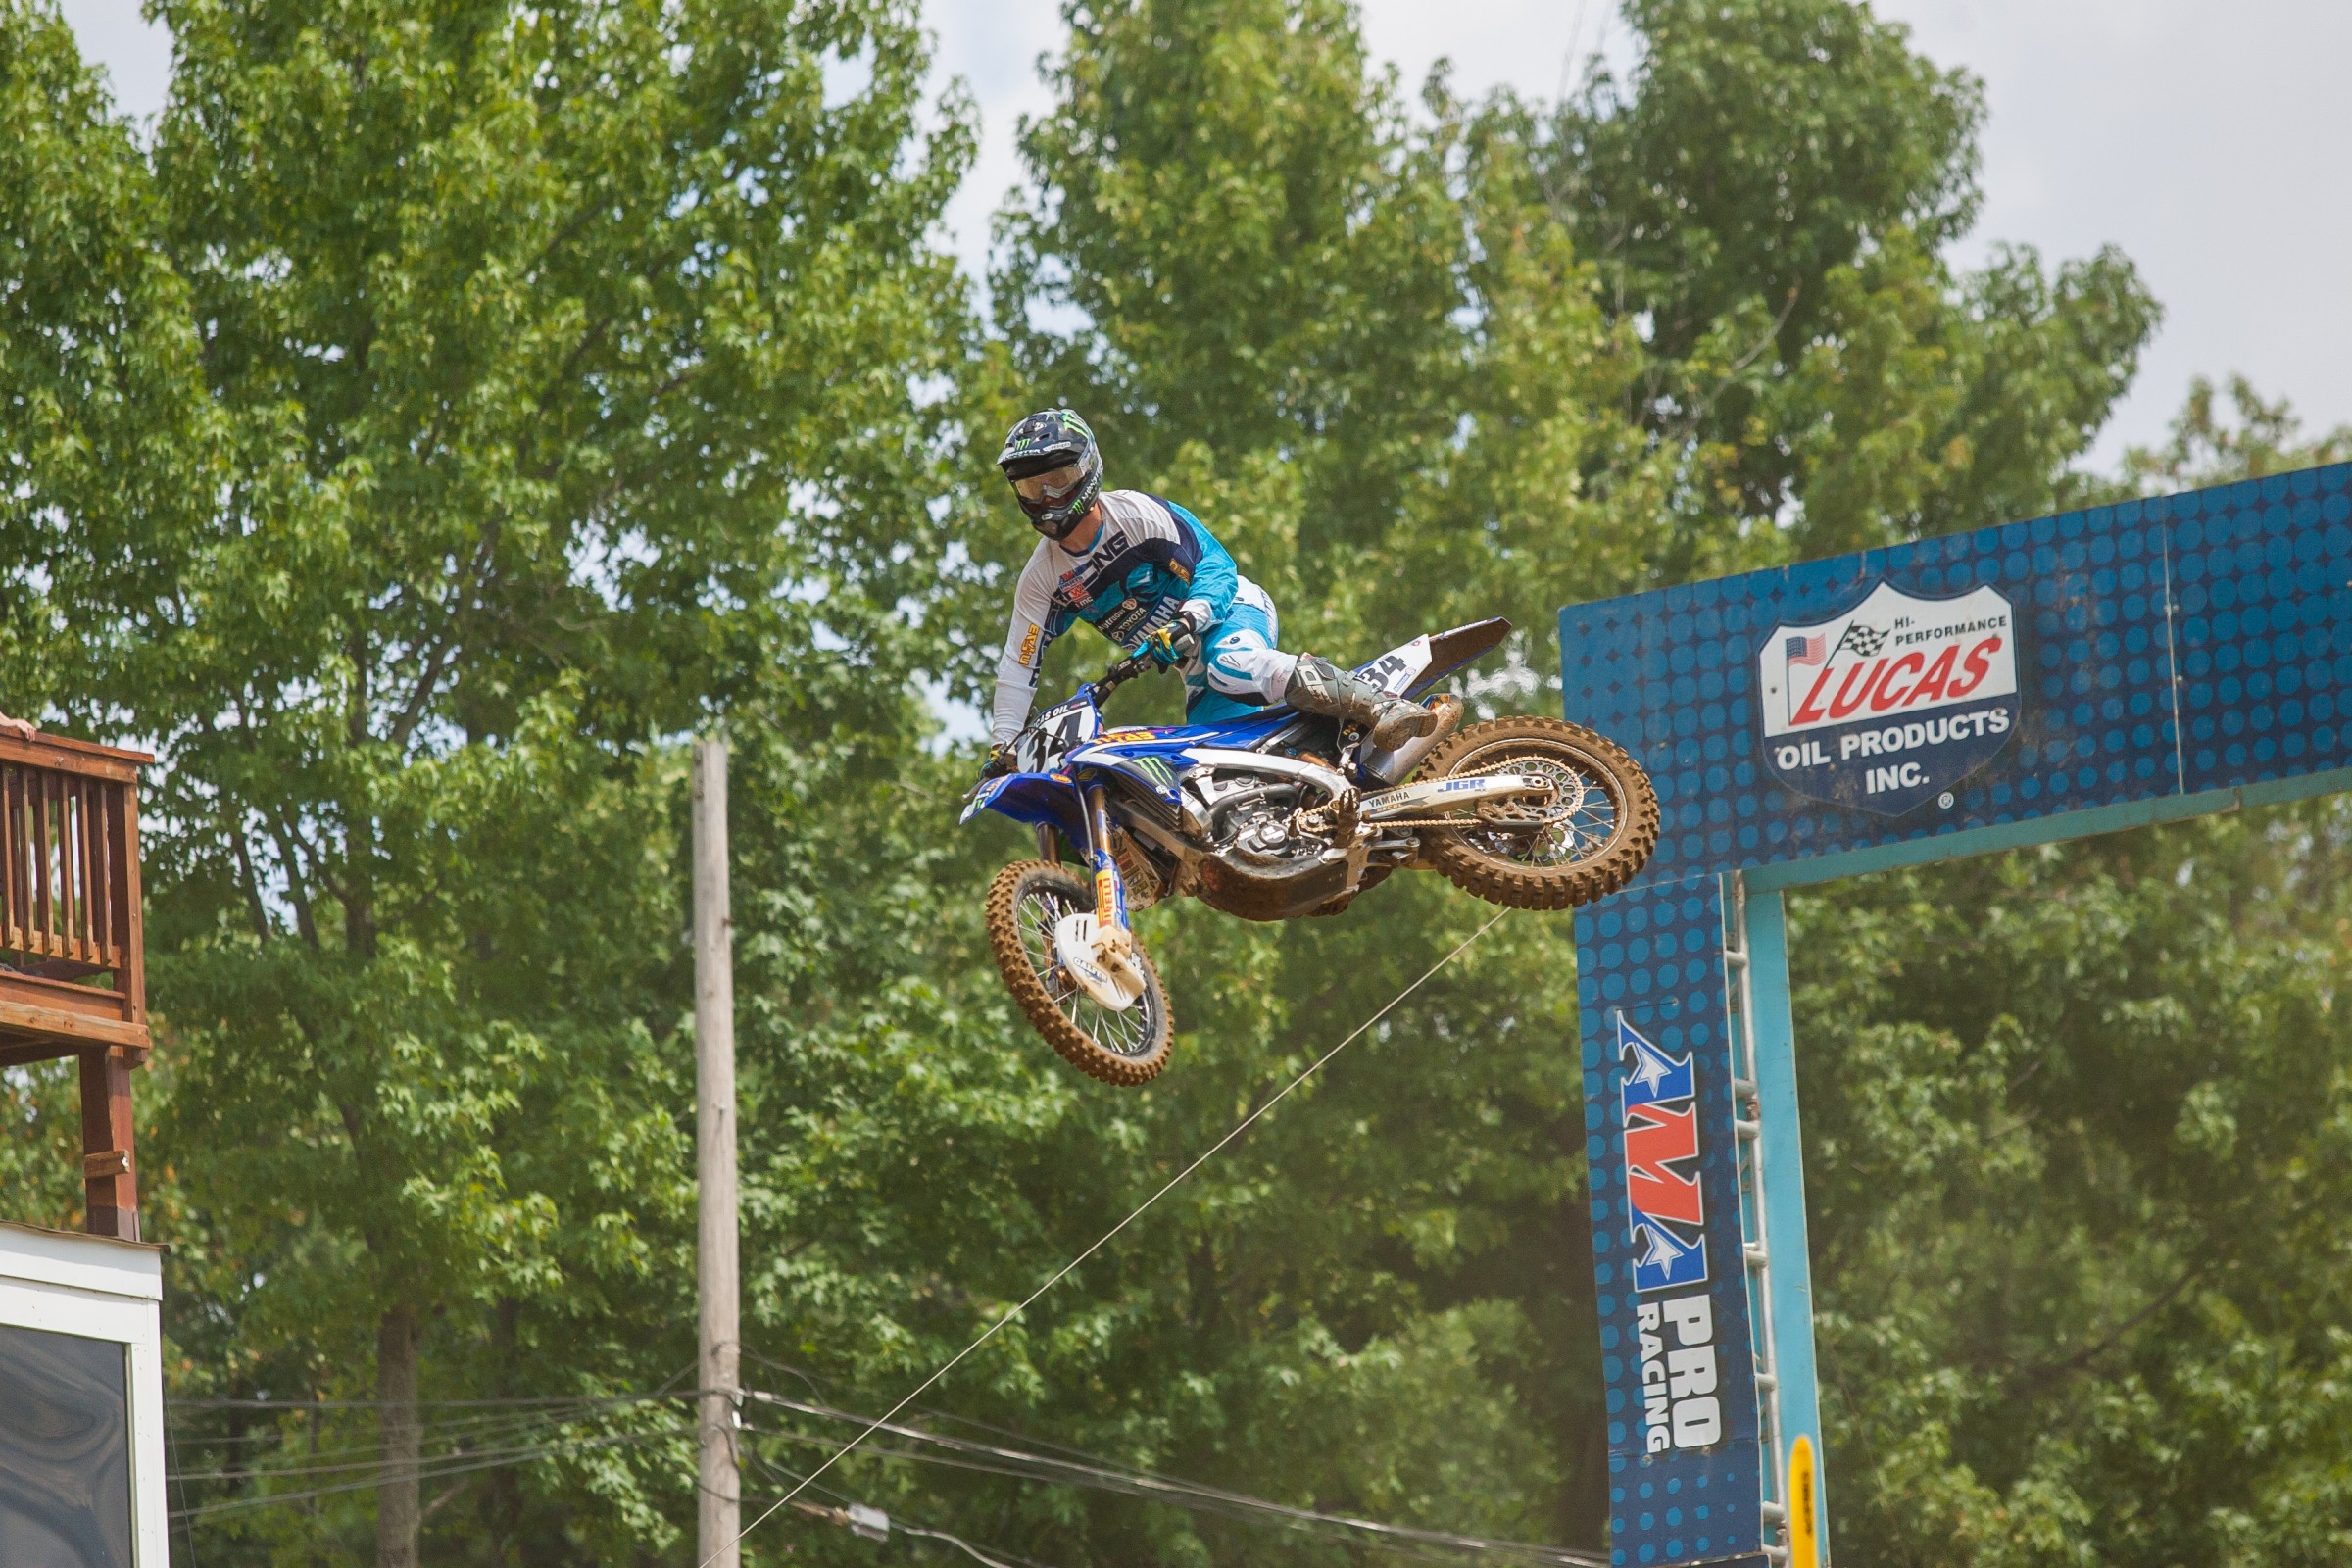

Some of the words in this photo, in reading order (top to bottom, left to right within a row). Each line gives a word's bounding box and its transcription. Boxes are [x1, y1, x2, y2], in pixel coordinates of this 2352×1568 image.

[1117, 606, 1147, 631] TOYOTA
[1894, 616, 1916, 630] HI-
[1895, 615, 2008, 647] PERFORMANCE
[1358, 655, 1408, 692] 34
[1789, 637, 2003, 727] LUCAS
[1052, 704, 1069, 716] OIL
[1025, 710, 1083, 773] 34
[1777, 740, 1832, 771] OIL
[1840, 706, 2010, 760] PRODUCTS
[1437, 779, 1486, 793] JGR
[1865, 761, 1930, 795] INC.
[1368, 791, 1410, 808] YAMAHA
[1617, 1008, 1709, 1293] AMA
[1636, 1304, 1671, 1454] RACING
[1663, 1294, 1722, 1449] PRO
